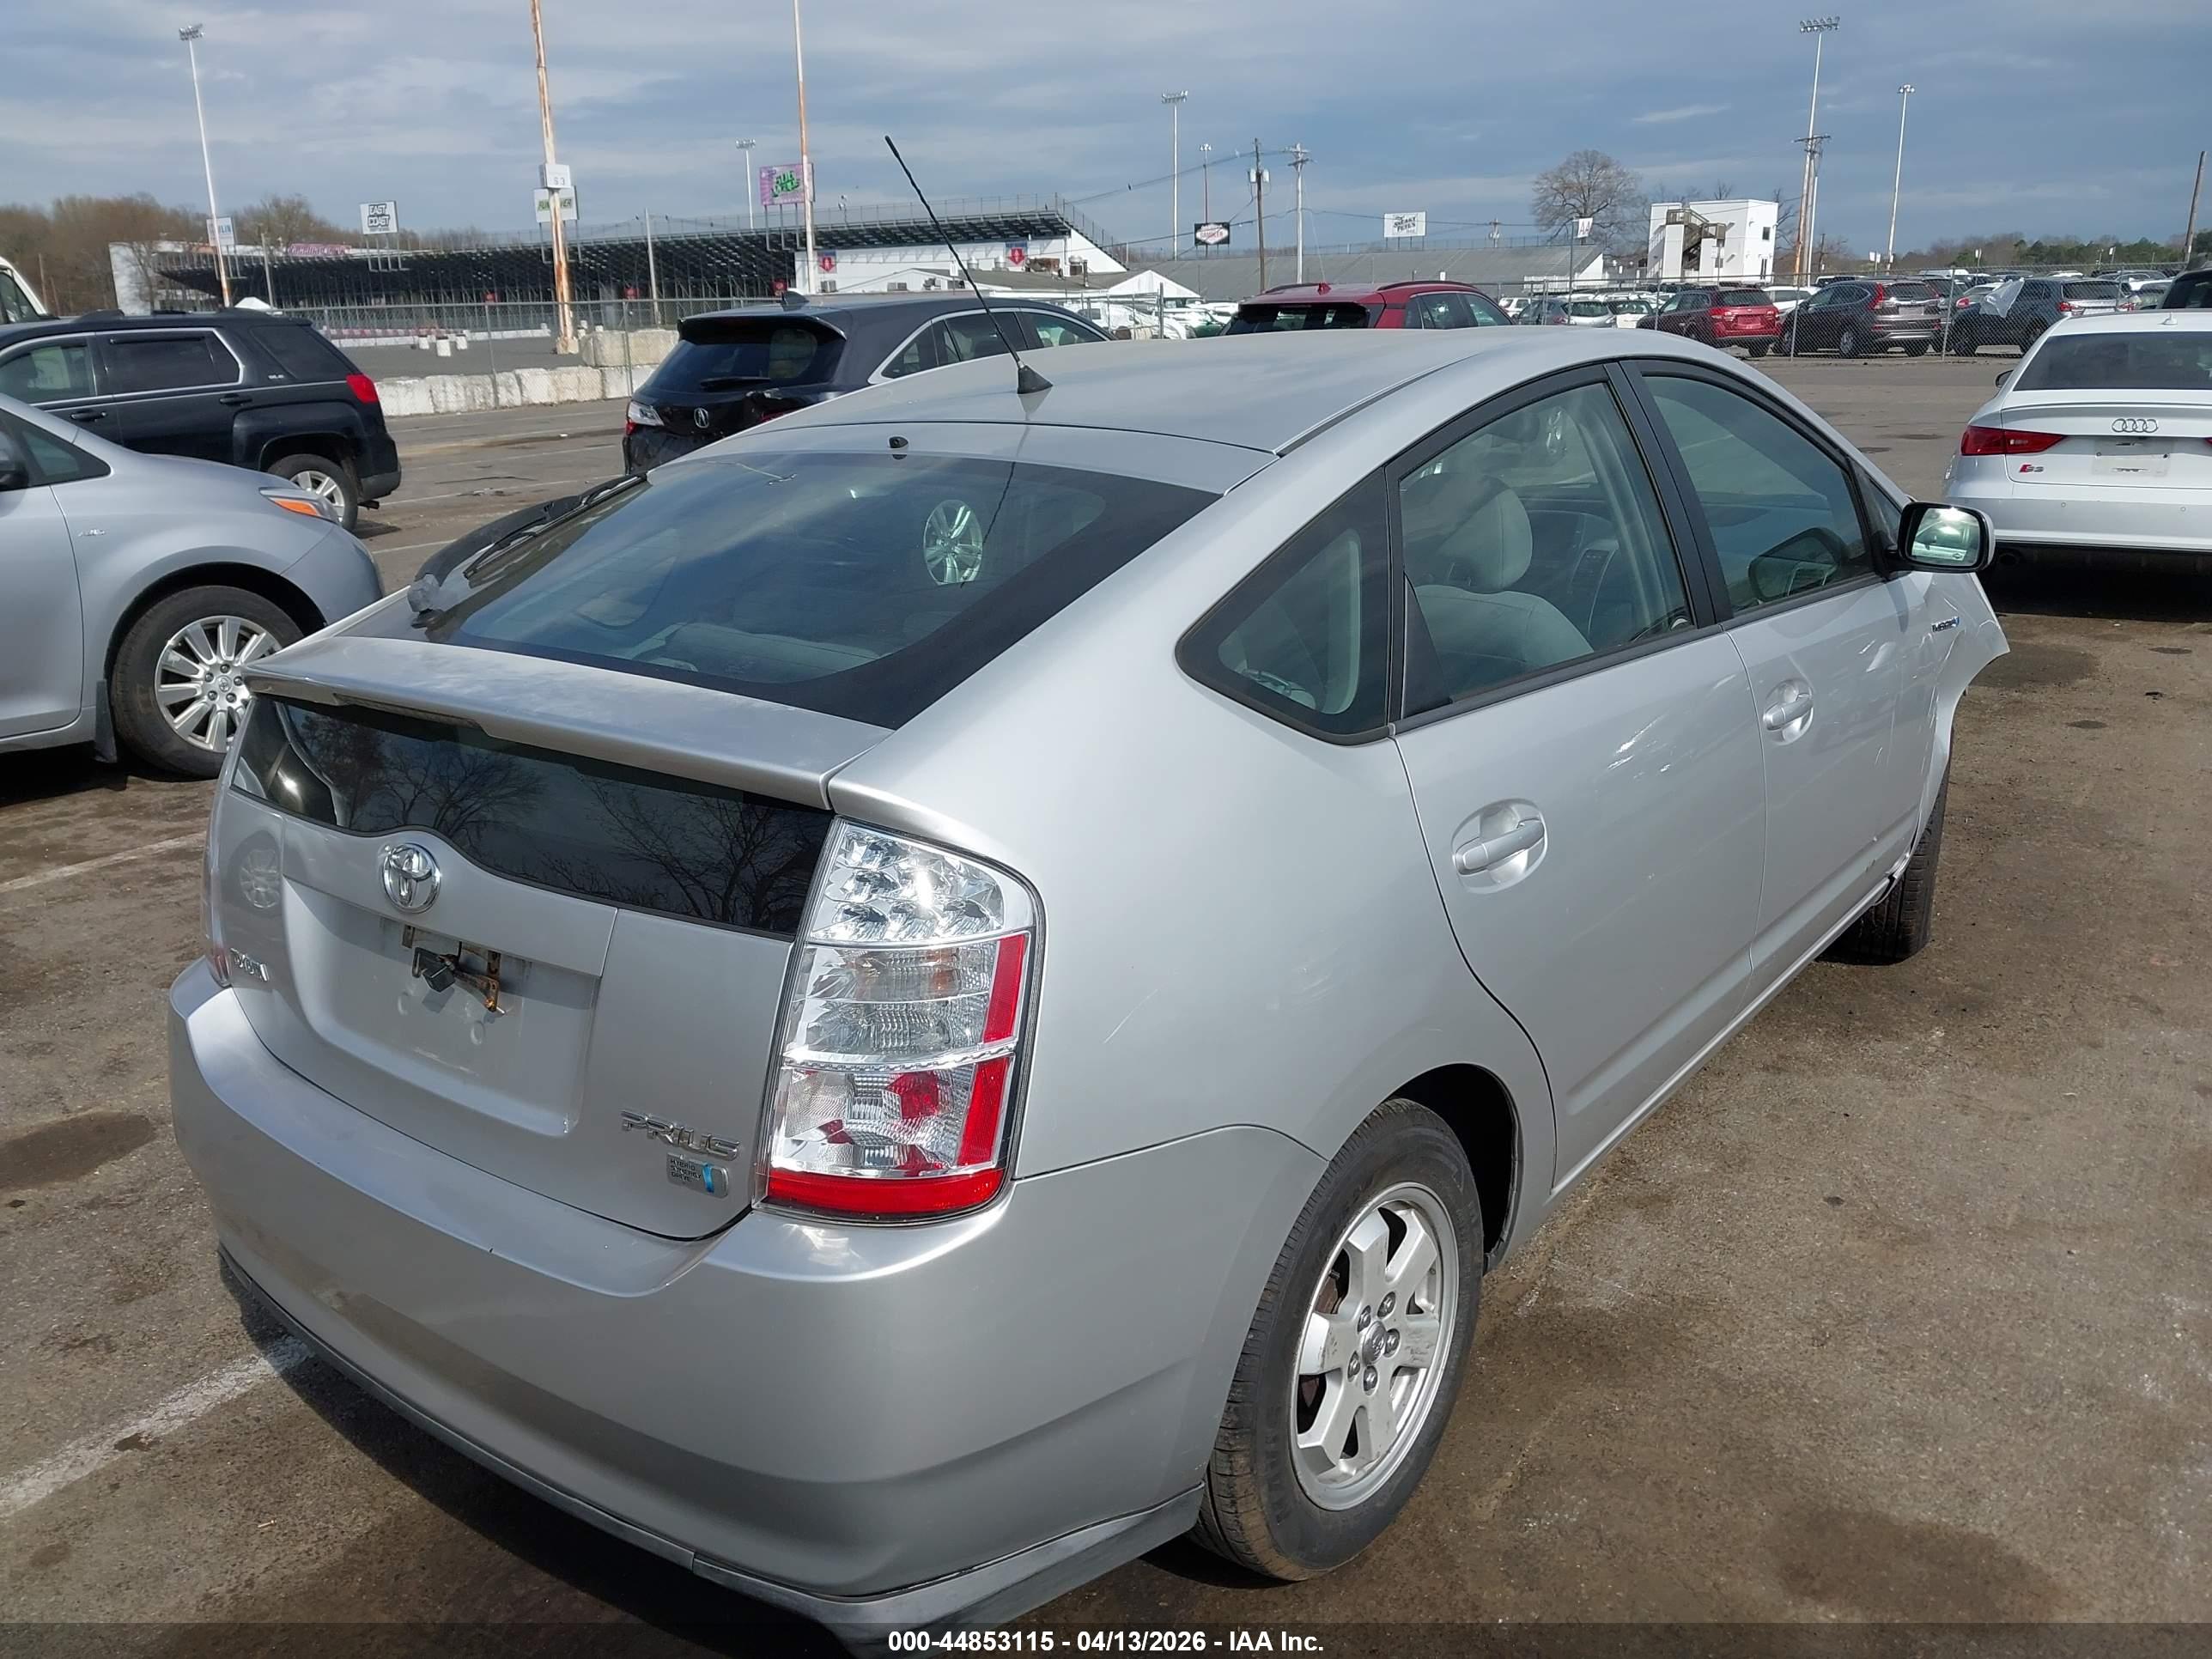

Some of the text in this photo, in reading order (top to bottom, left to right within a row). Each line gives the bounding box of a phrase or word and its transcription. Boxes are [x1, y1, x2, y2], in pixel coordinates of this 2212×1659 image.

[368, 203, 387, 215] EAST
[367, 214, 391, 228] COAST
[620, 1109, 741, 1161] PRIUS
[670, 1157, 696, 1171] HYBRID
